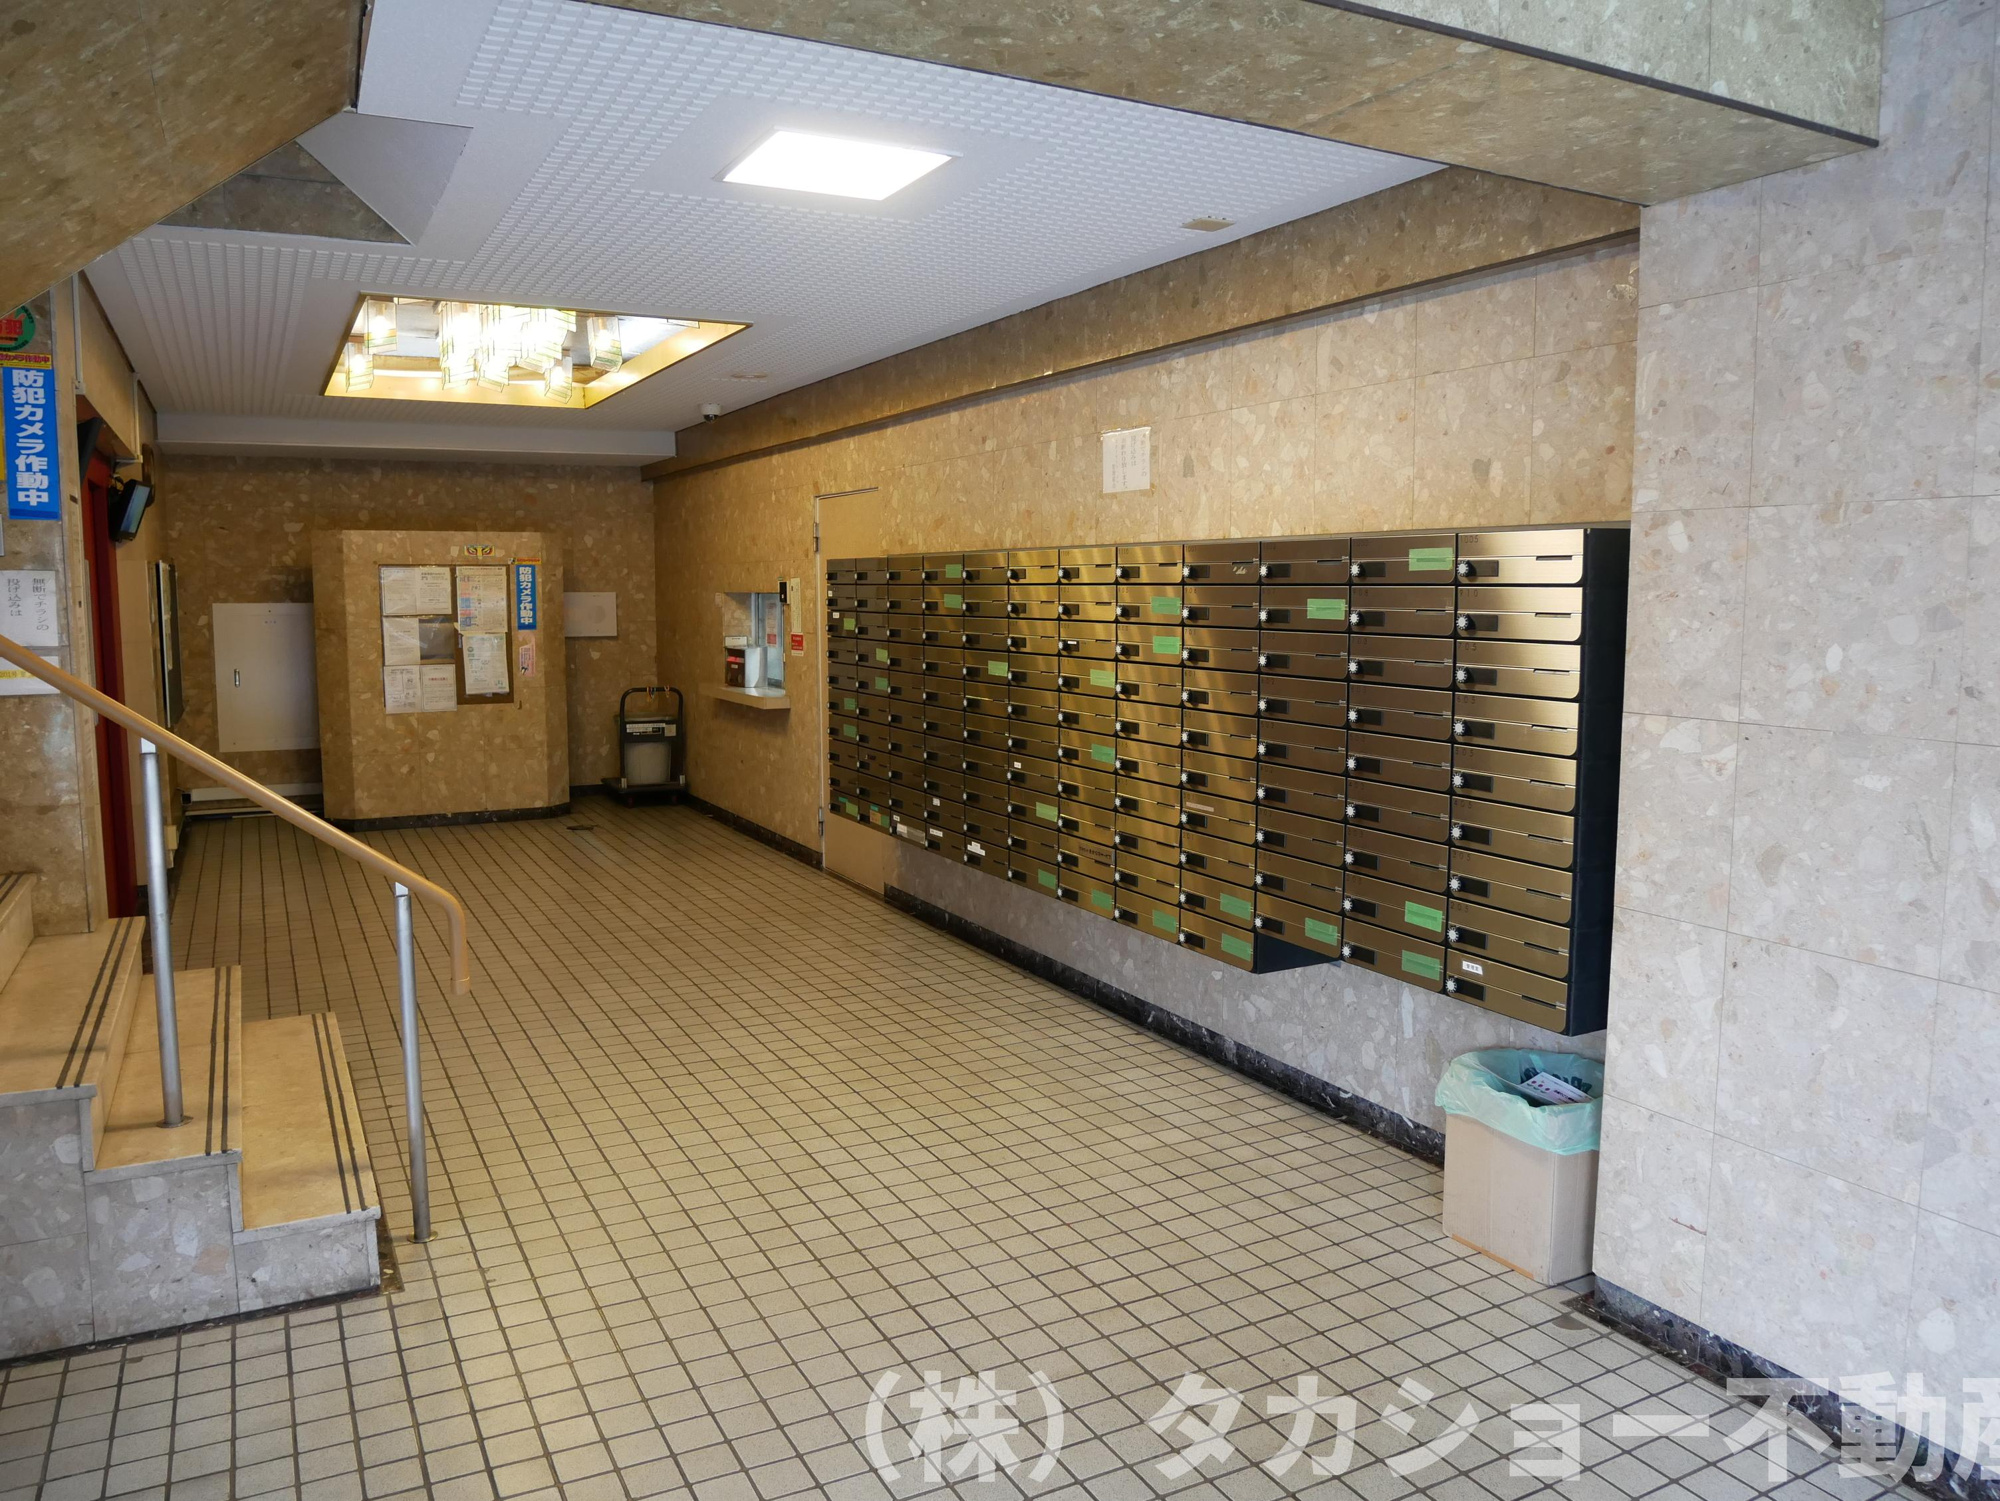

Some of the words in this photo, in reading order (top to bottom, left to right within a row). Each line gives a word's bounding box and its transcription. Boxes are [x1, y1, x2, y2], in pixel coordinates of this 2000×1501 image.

[12, 369, 49, 507] 防犯カメラ作動中
[1460, 535, 1479, 544] 1005
[7, 577, 23, 618] 投げ込みは
[519, 566, 534, 625] 防犯カメラ作動中
[1459, 589, 1478, 598] 910
